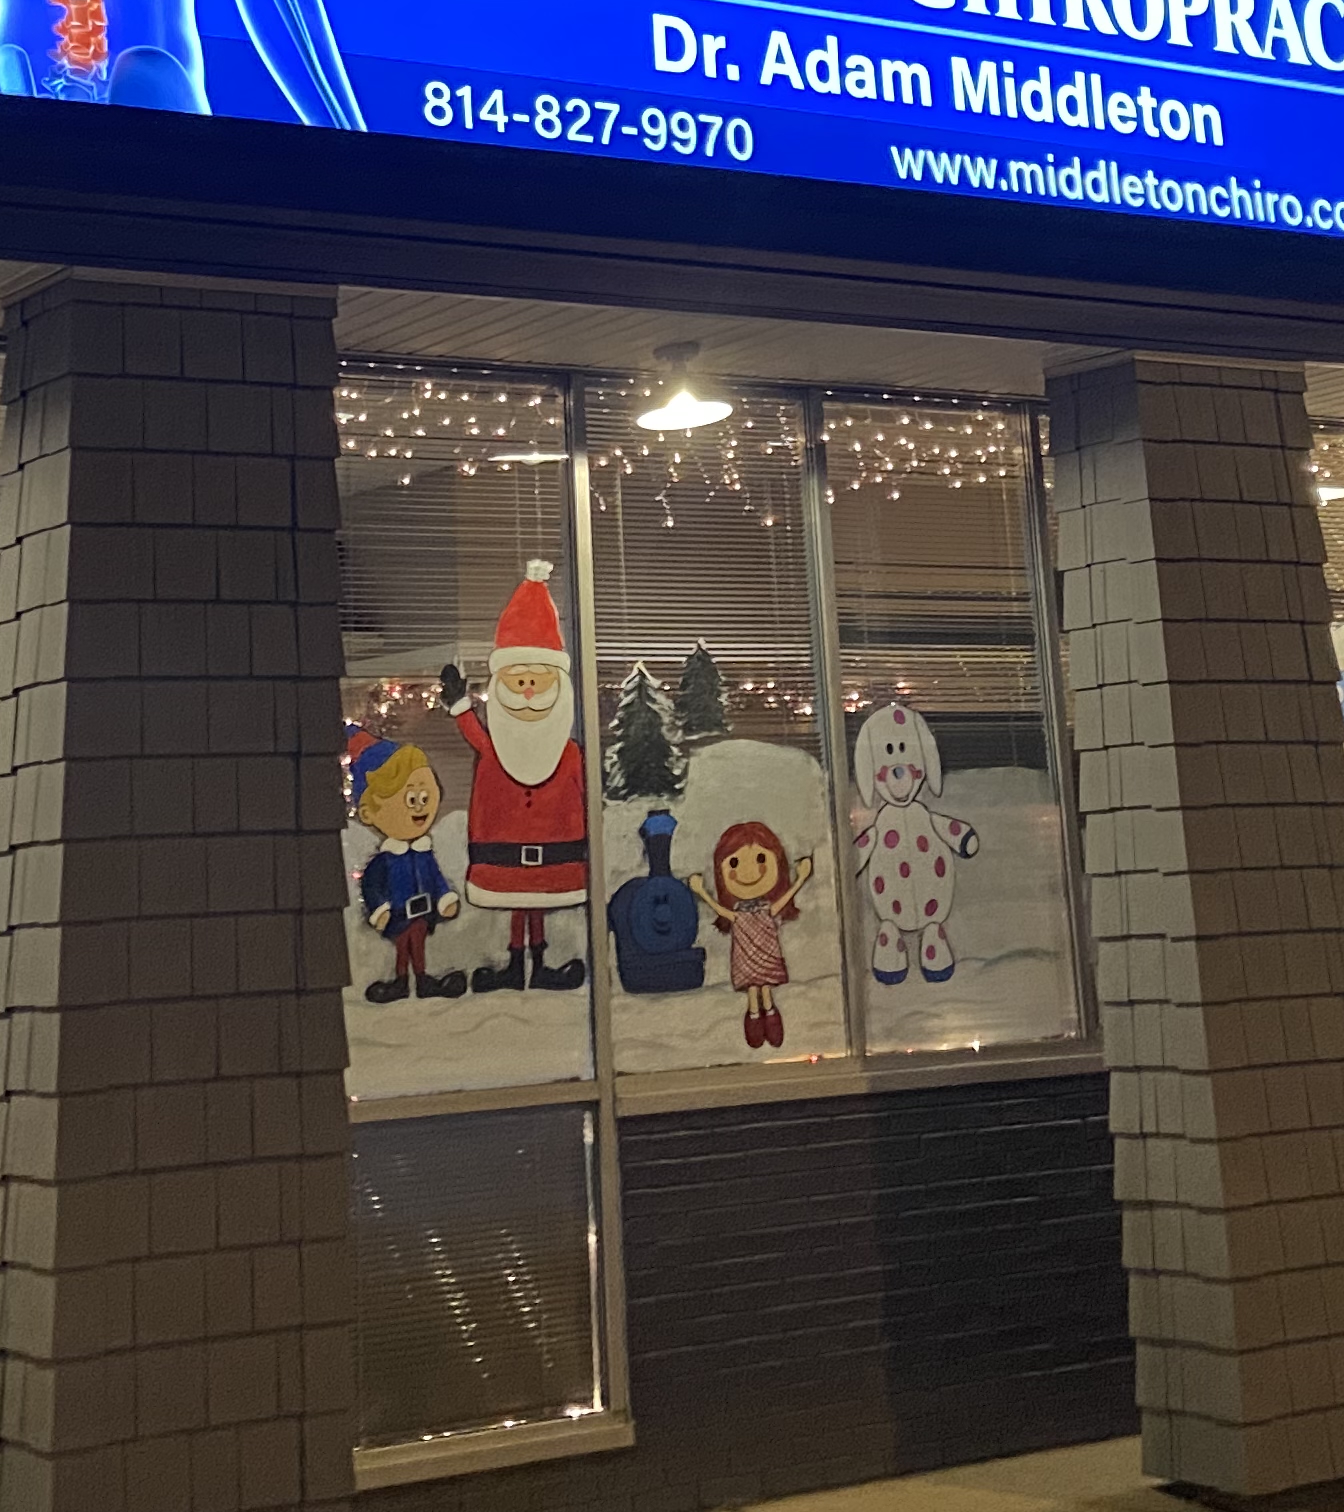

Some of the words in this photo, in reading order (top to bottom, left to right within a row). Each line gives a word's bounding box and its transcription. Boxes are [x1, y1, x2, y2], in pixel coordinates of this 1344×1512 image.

[423, 81, 753, 161] 814-827-9970
[652, 13, 740, 81] Dr.
[760, 30, 933, 108] Adam
[951, 56, 1224, 146] Middleton
